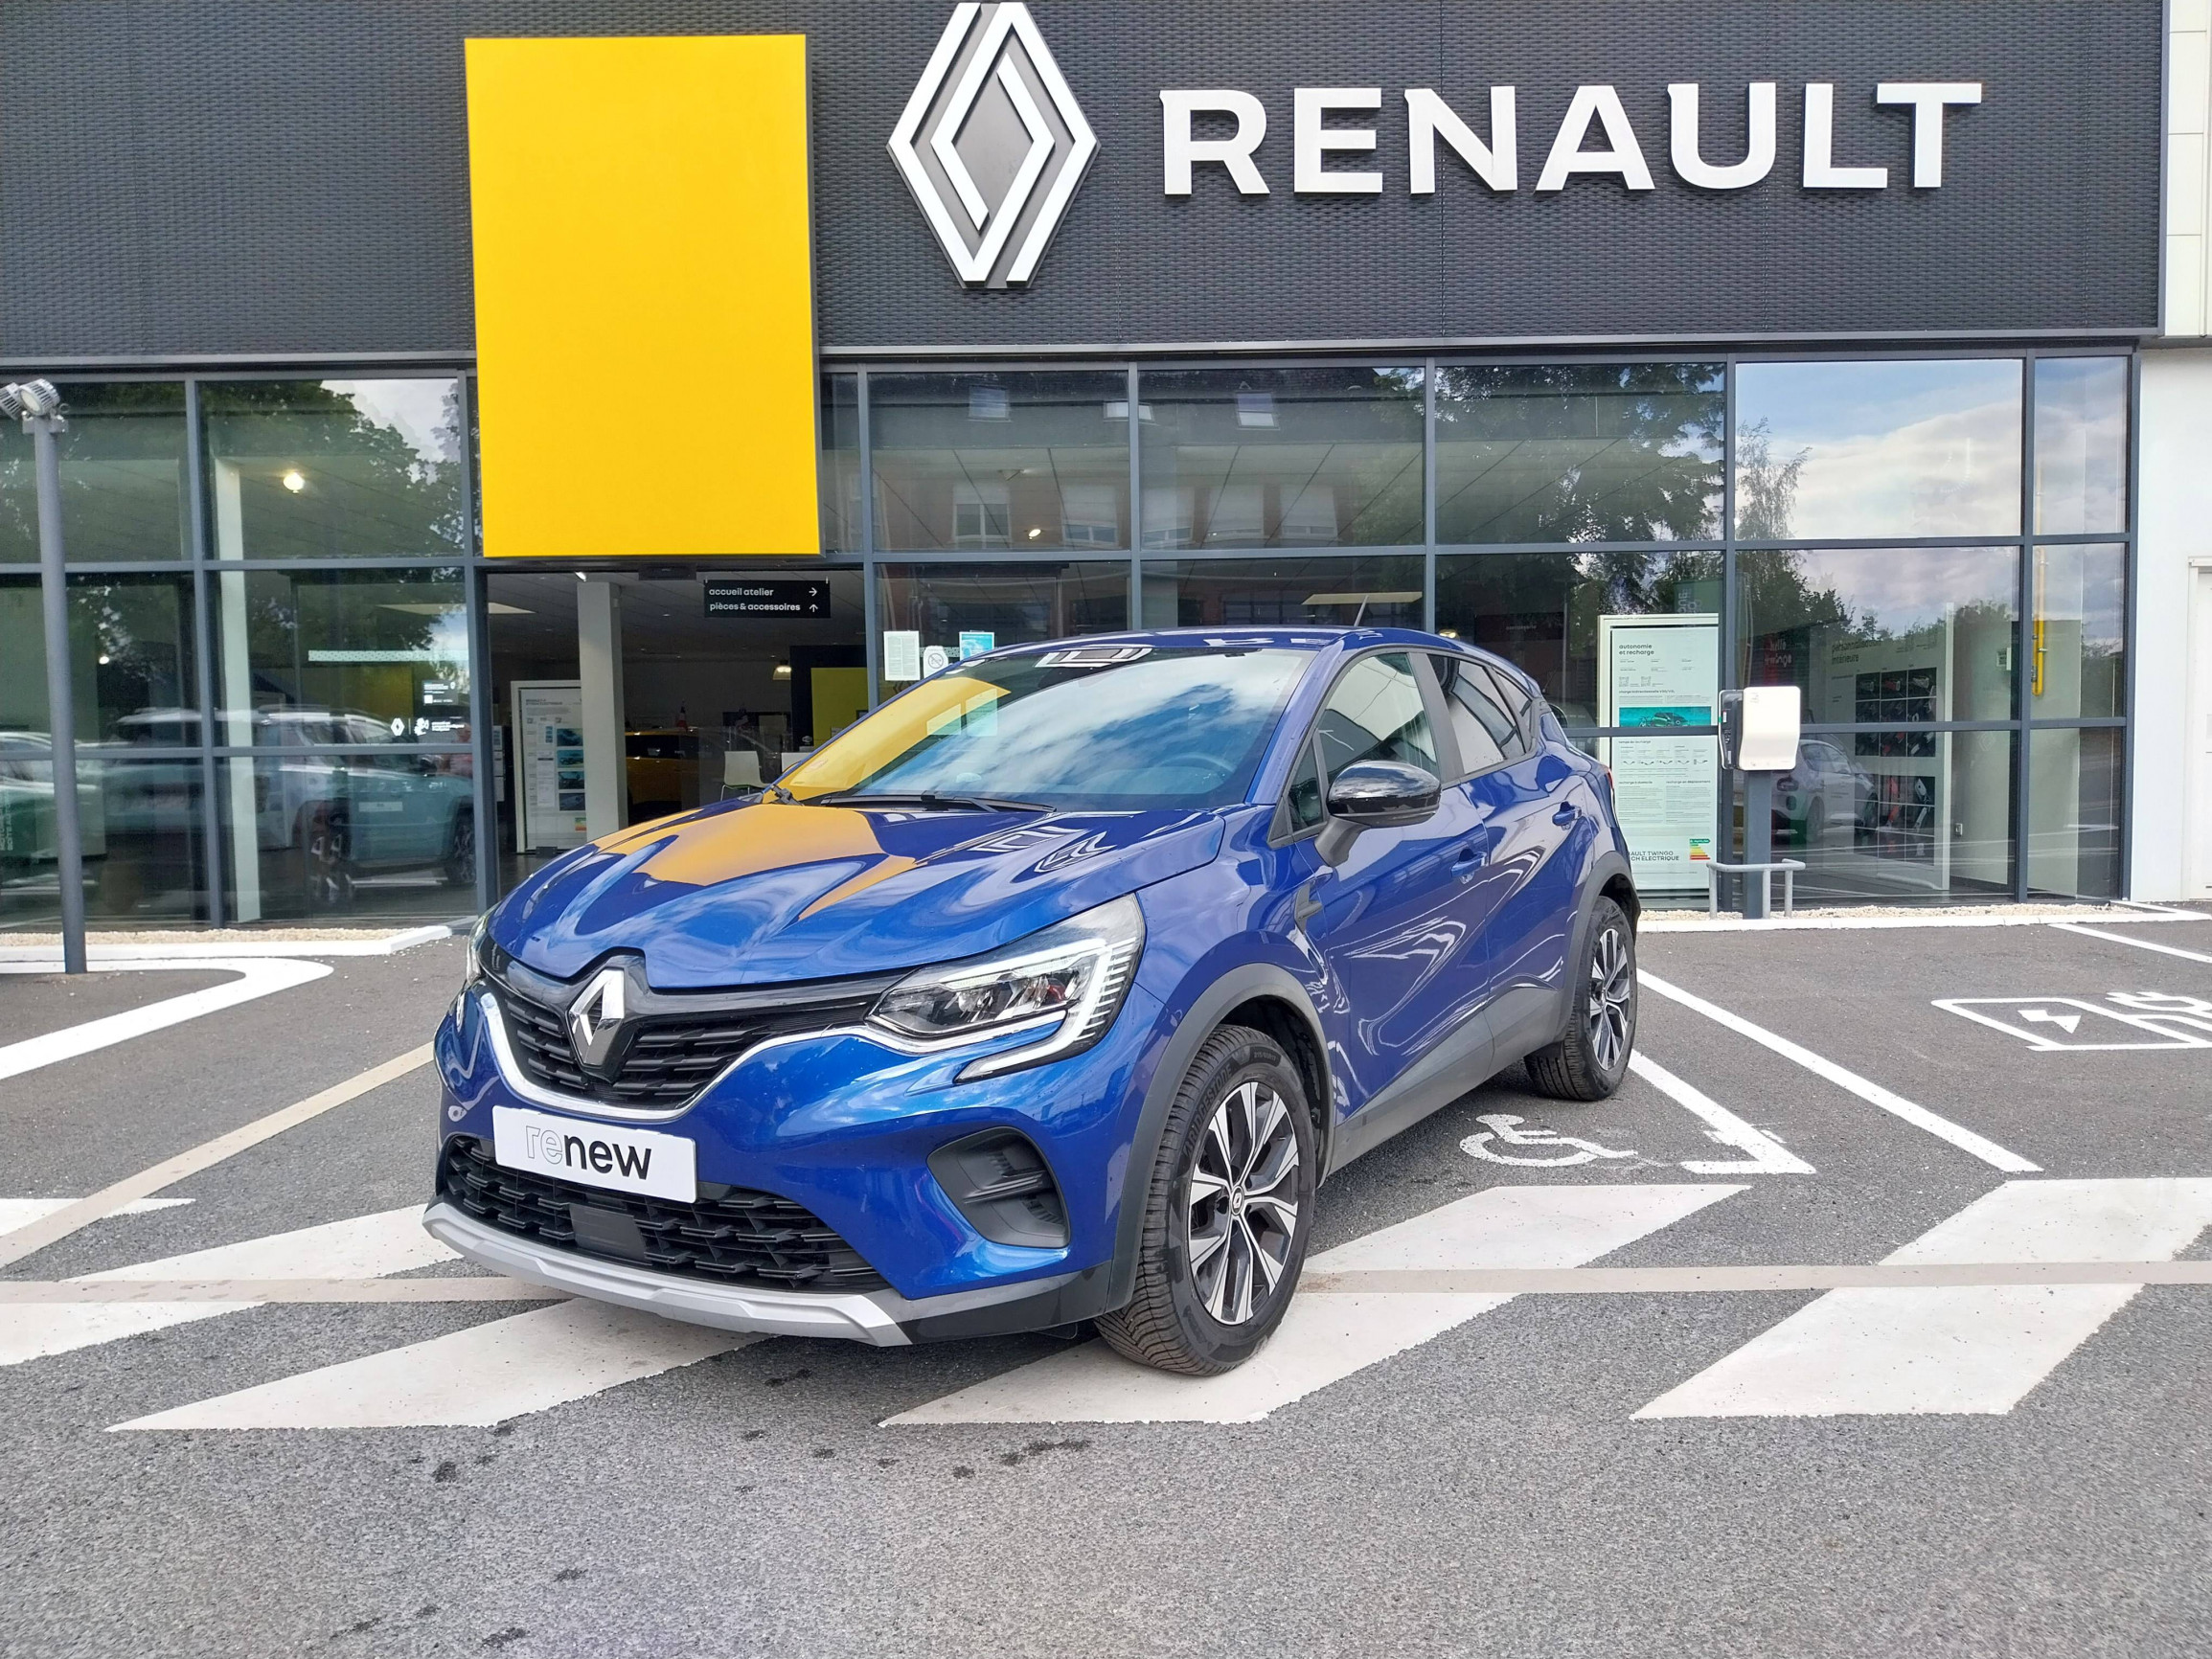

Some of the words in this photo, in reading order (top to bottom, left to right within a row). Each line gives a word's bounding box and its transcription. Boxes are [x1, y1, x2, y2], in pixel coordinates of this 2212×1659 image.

[1159, 81, 1982, 196] RENAULT
[709, 587, 741, 596] accueil
[743, 587, 774, 596] atelier
[710, 602, 739, 611] pièces
[740, 602, 746, 611] &
[747, 602, 801, 611] accessoires
[1183, 1063, 1234, 1158] BRIDGESTONE
[525, 1125, 652, 1180] renew
